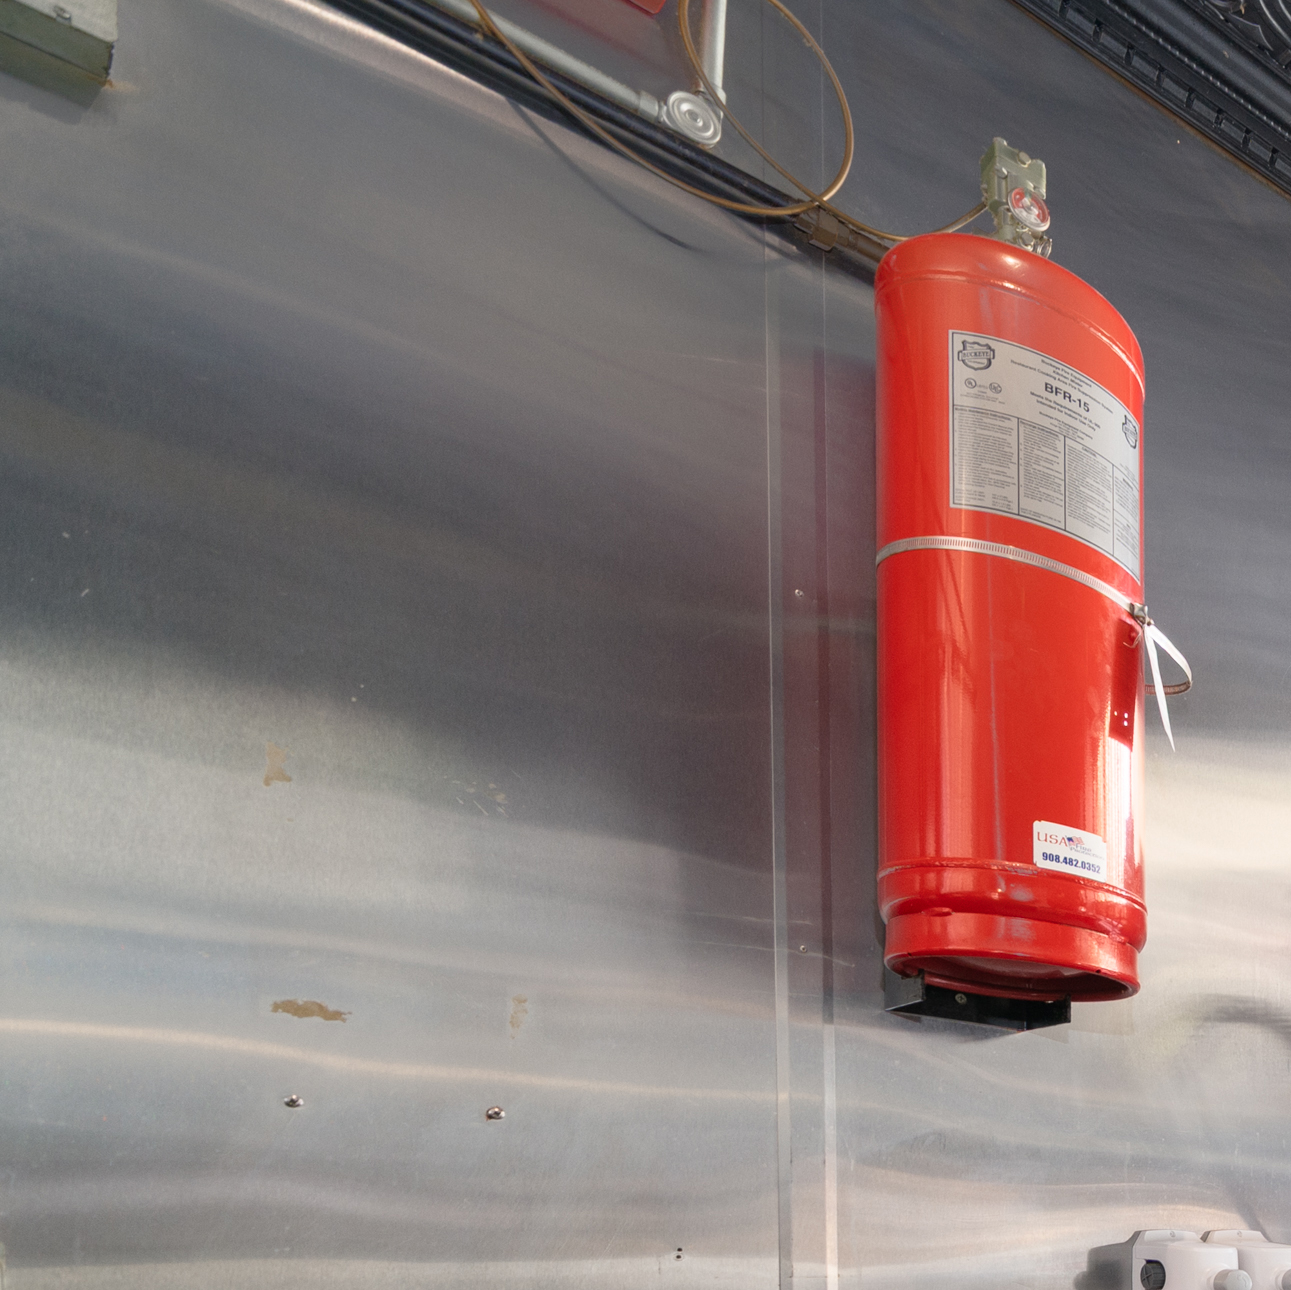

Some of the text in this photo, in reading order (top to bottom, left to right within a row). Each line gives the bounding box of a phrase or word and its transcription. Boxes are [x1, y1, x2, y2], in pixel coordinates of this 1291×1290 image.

[962, 350, 990, 358] BUCKEYE
[1044, 381, 1090, 413] BFR-15
[1037, 831, 1068, 847] USA
[1042, 851, 1101, 875] 908.482.0352
